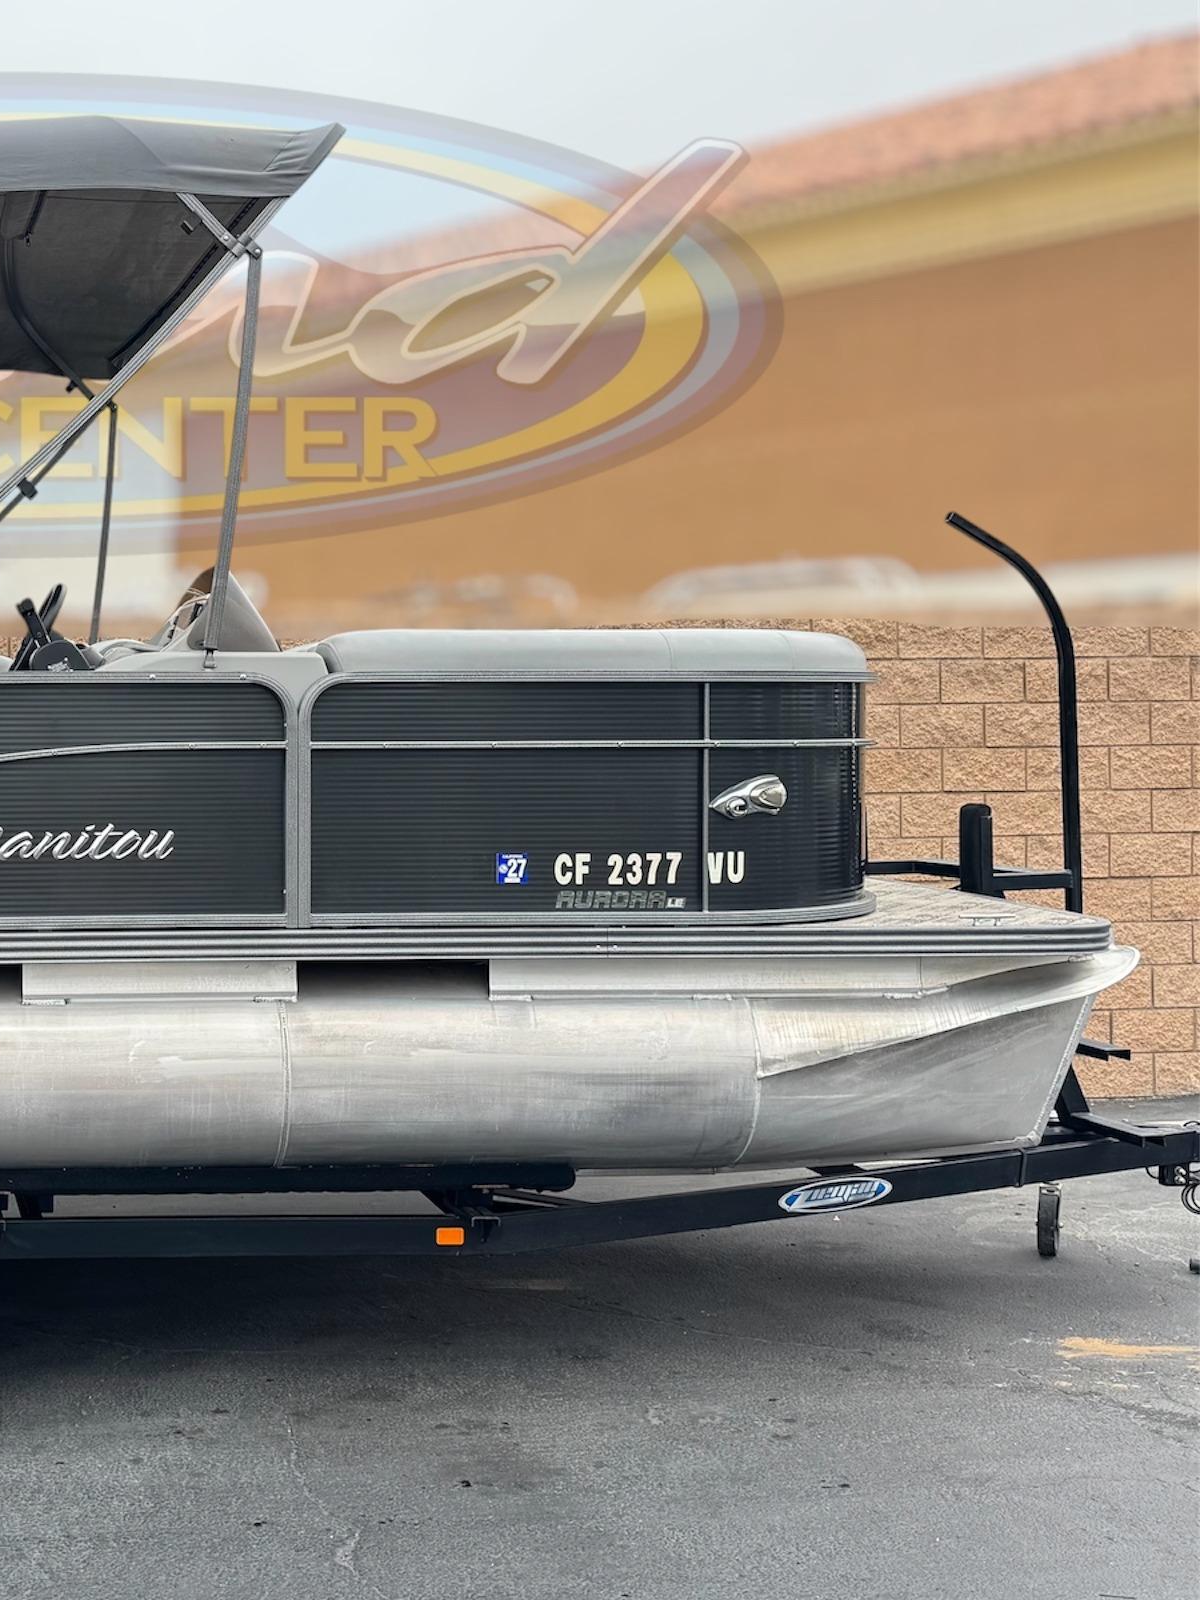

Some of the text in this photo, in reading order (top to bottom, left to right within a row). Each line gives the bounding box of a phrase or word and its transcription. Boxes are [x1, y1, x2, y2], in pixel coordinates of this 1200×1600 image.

[506, 857, 528, 879] 27
[553, 850, 746, 886] CF 2377 VU
